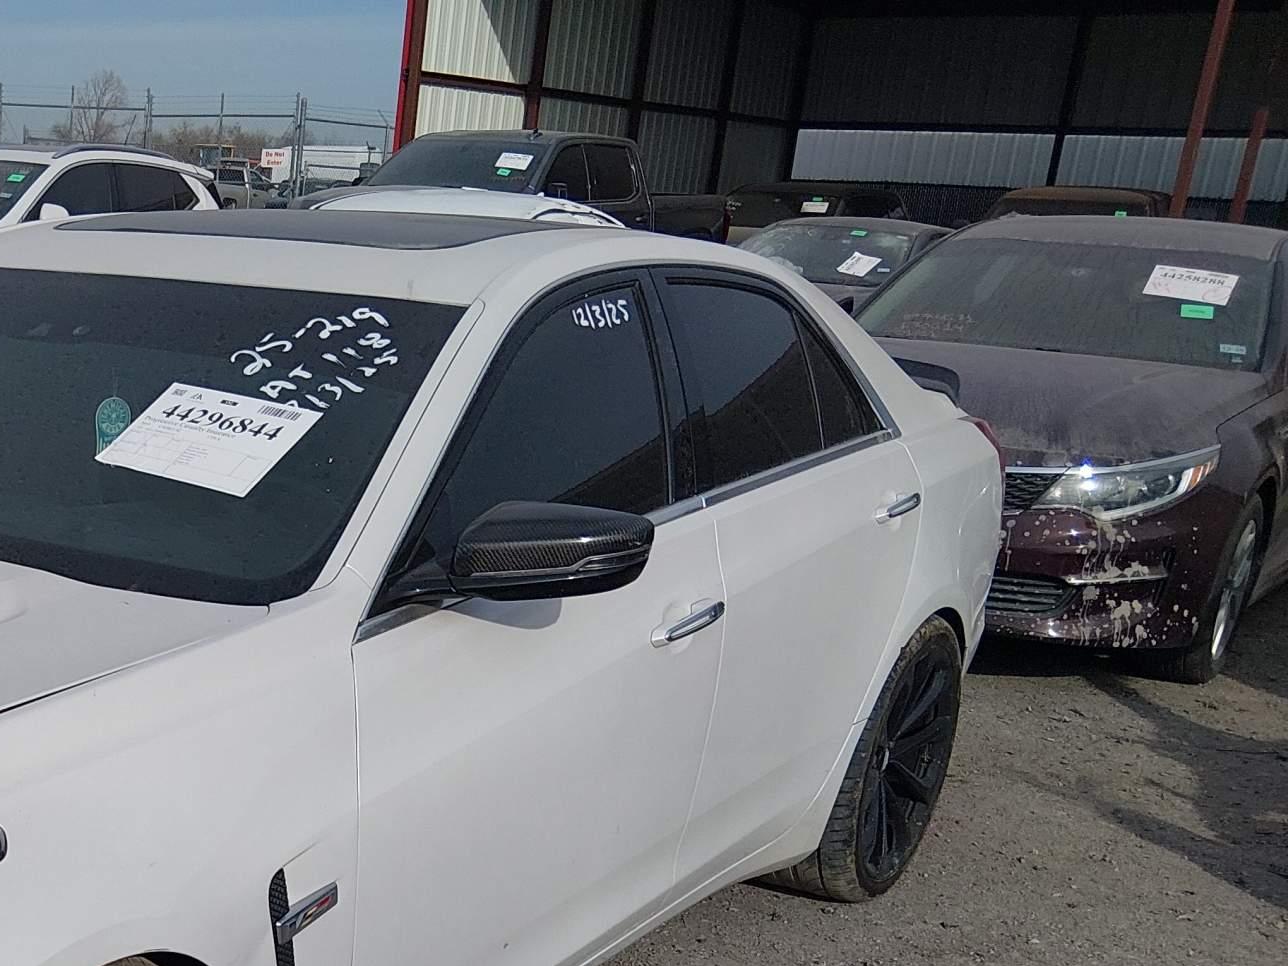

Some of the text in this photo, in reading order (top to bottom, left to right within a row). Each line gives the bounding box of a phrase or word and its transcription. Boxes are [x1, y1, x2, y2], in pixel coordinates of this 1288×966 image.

[572, 299, 629, 329] 12/3/25
[230, 307, 390, 376] 25-219
[162, 404, 284, 440] 44296844
